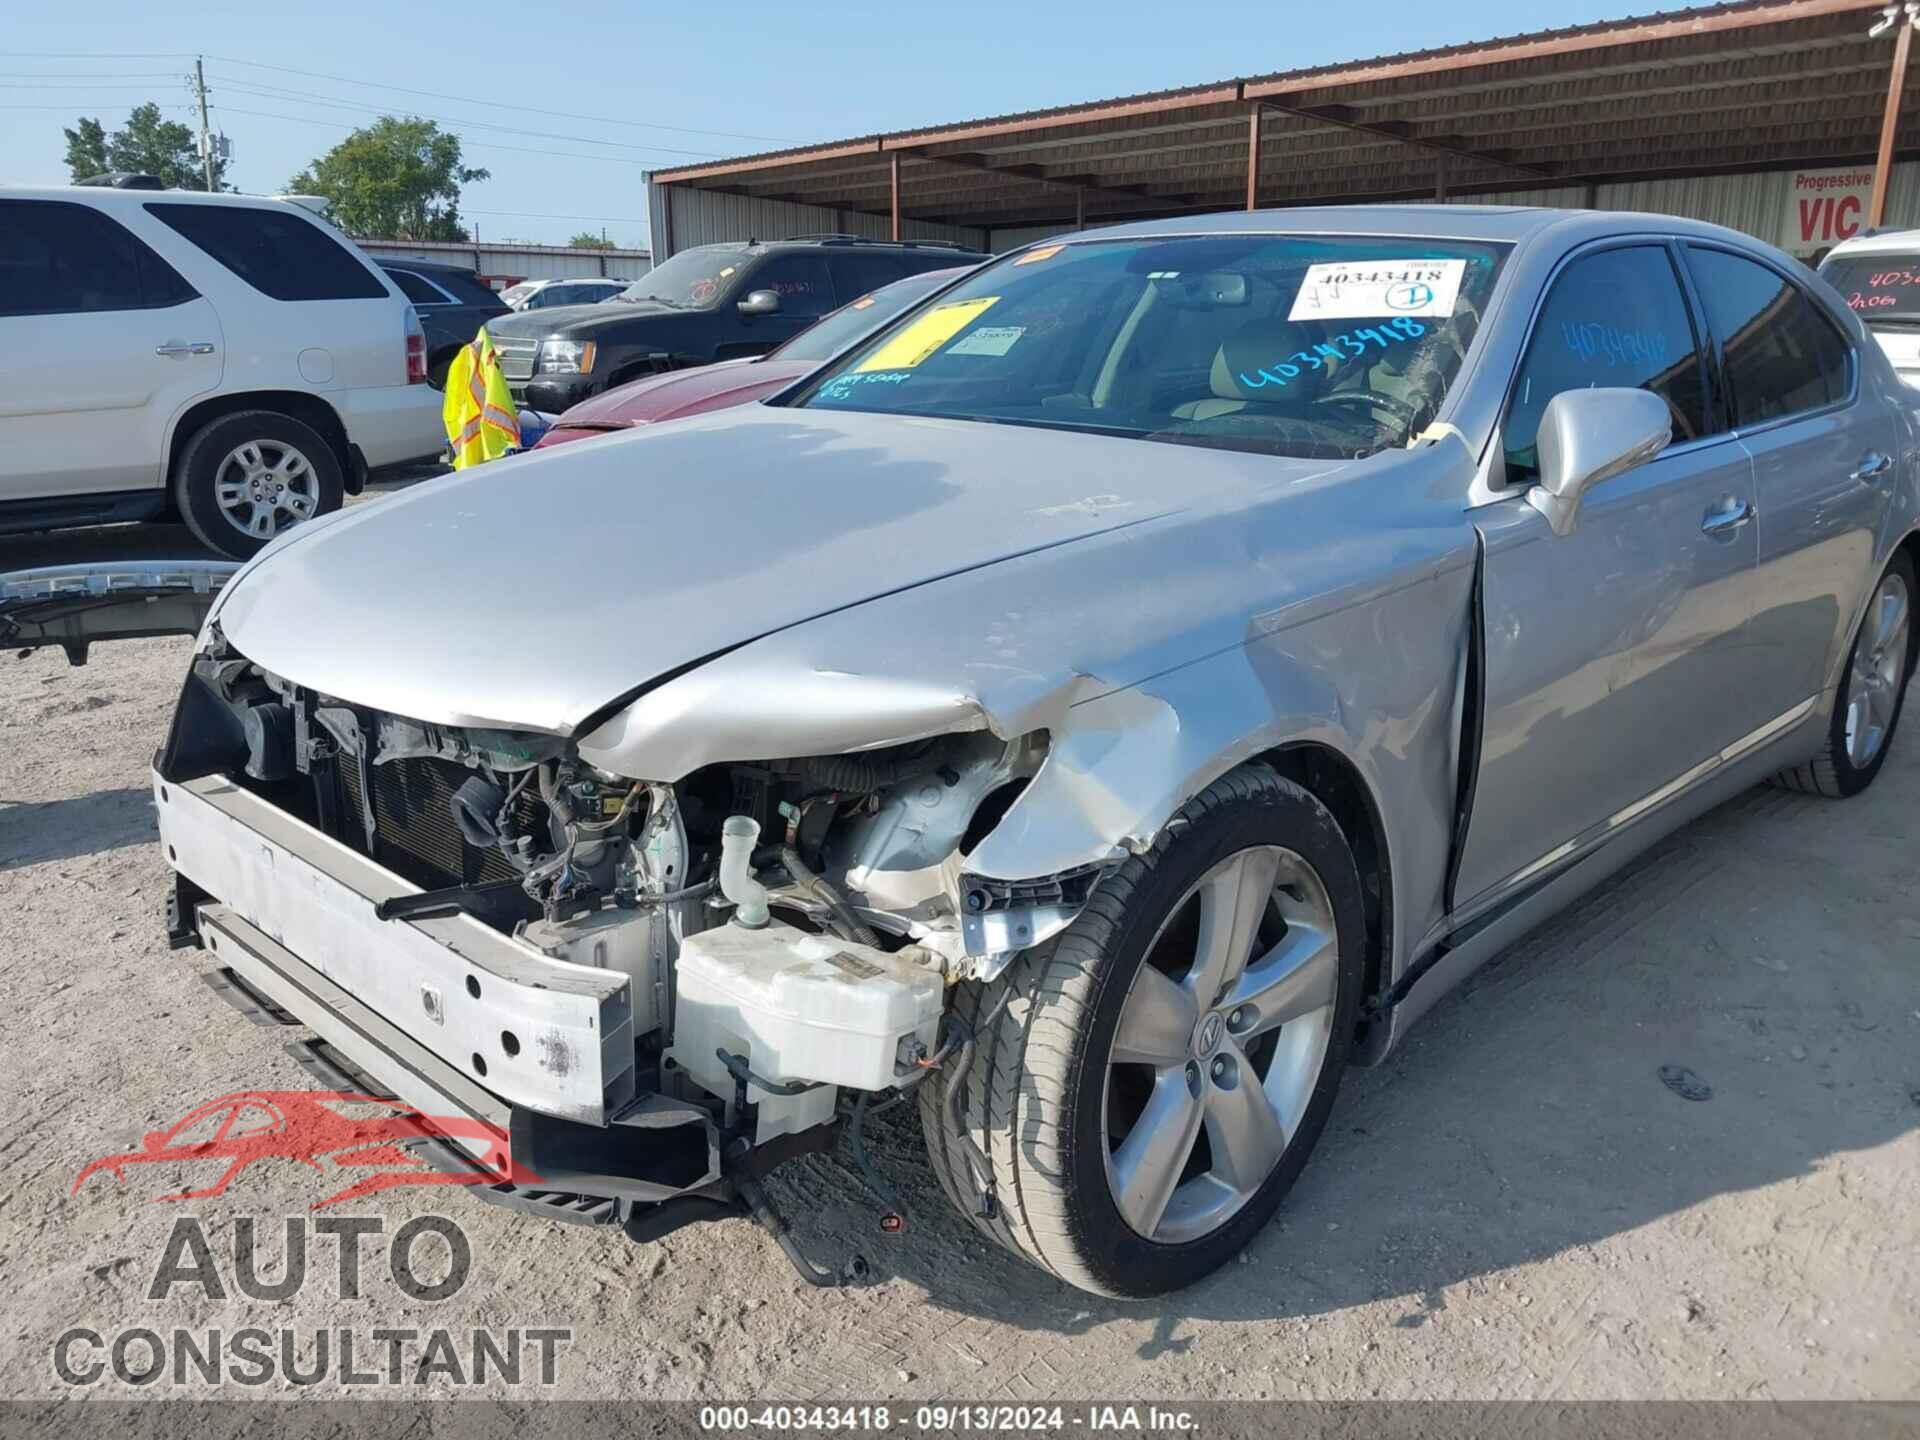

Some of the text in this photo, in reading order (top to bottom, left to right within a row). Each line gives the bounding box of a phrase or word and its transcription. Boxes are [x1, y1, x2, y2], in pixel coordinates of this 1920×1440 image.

[1795, 170, 1873, 192] Progressive
[1800, 194, 1861, 242] VIC
[1319, 270, 1442, 285] 40343418
[1239, 316, 1425, 388] 40343418
